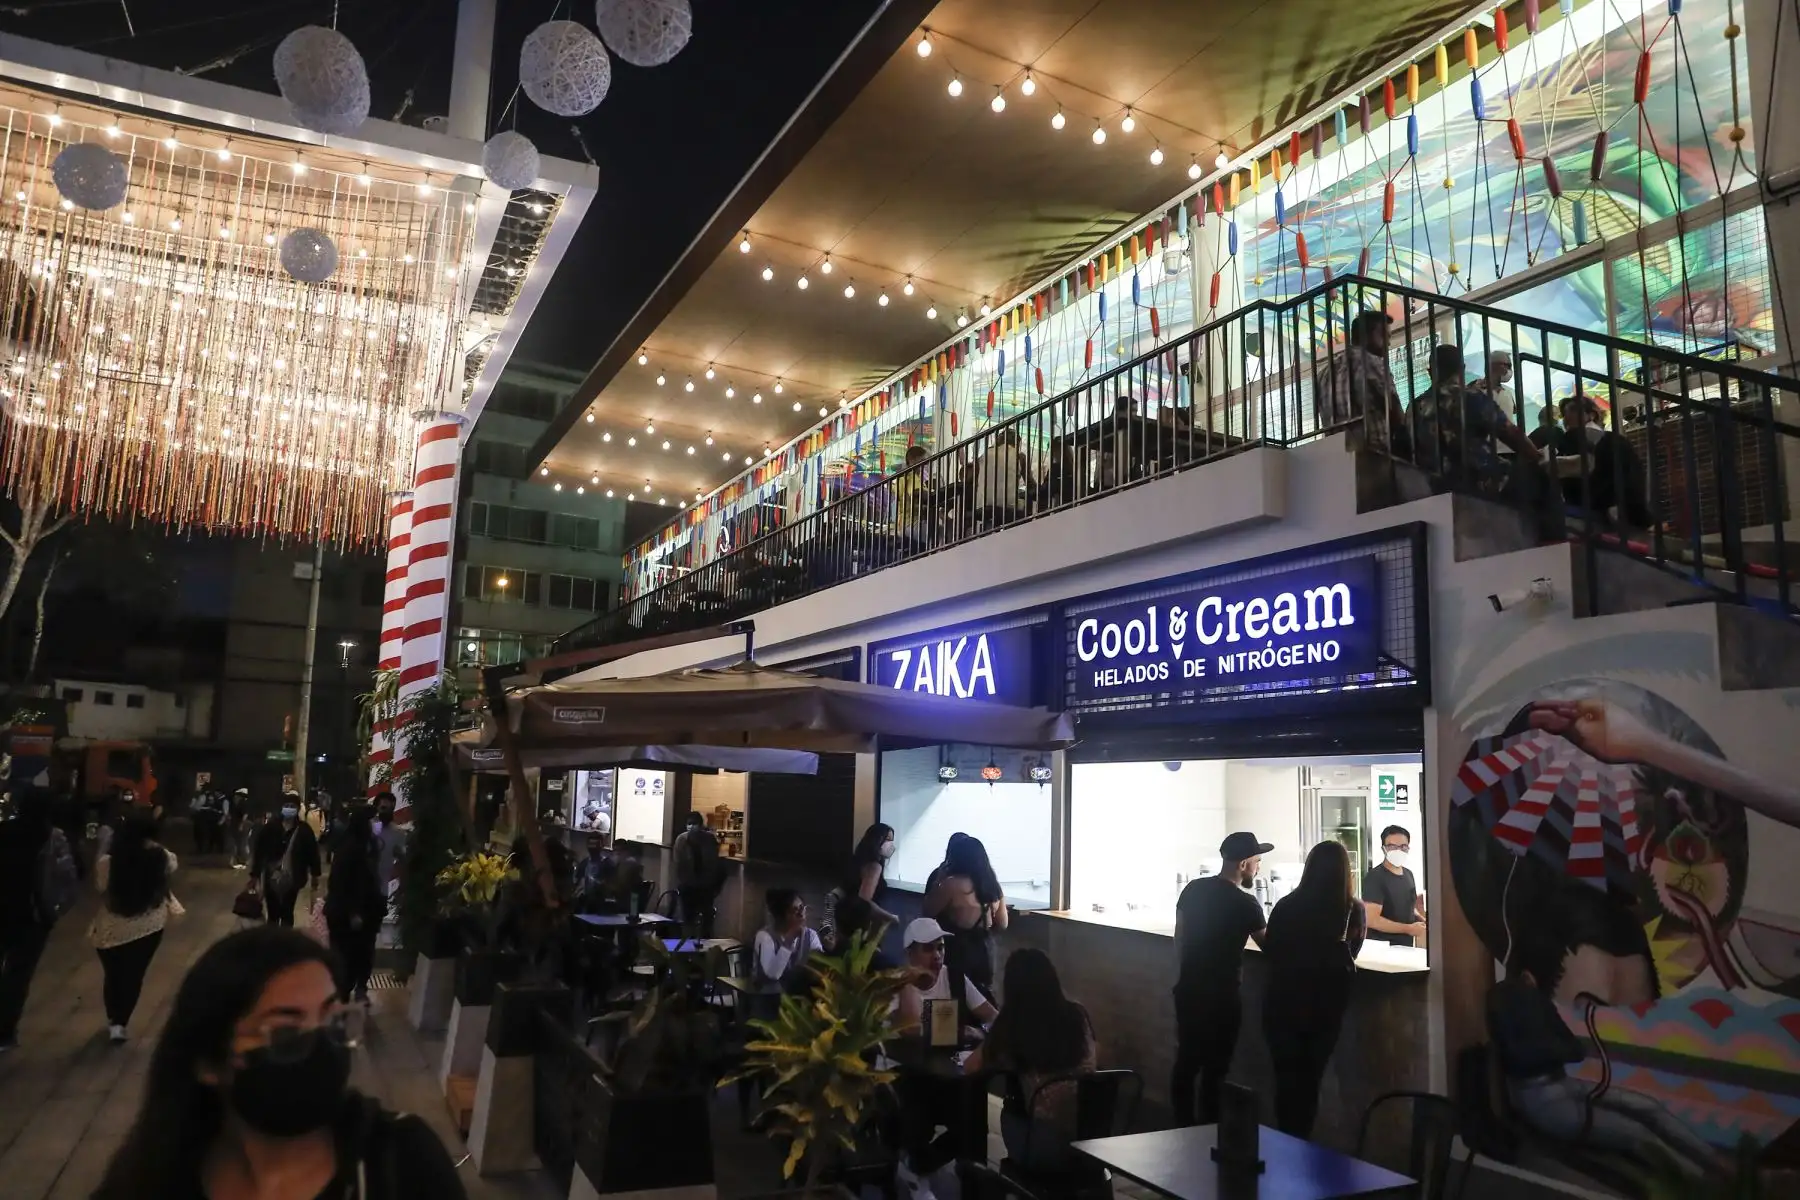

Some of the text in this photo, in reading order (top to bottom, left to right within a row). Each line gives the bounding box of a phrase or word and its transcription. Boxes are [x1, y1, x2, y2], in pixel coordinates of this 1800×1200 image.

[1077, 582, 1355, 662] Cool & Cream
[891, 633, 996, 699] ZAIKA
[1094, 639, 1340, 688] HELADOS DE NITRÓGENO
